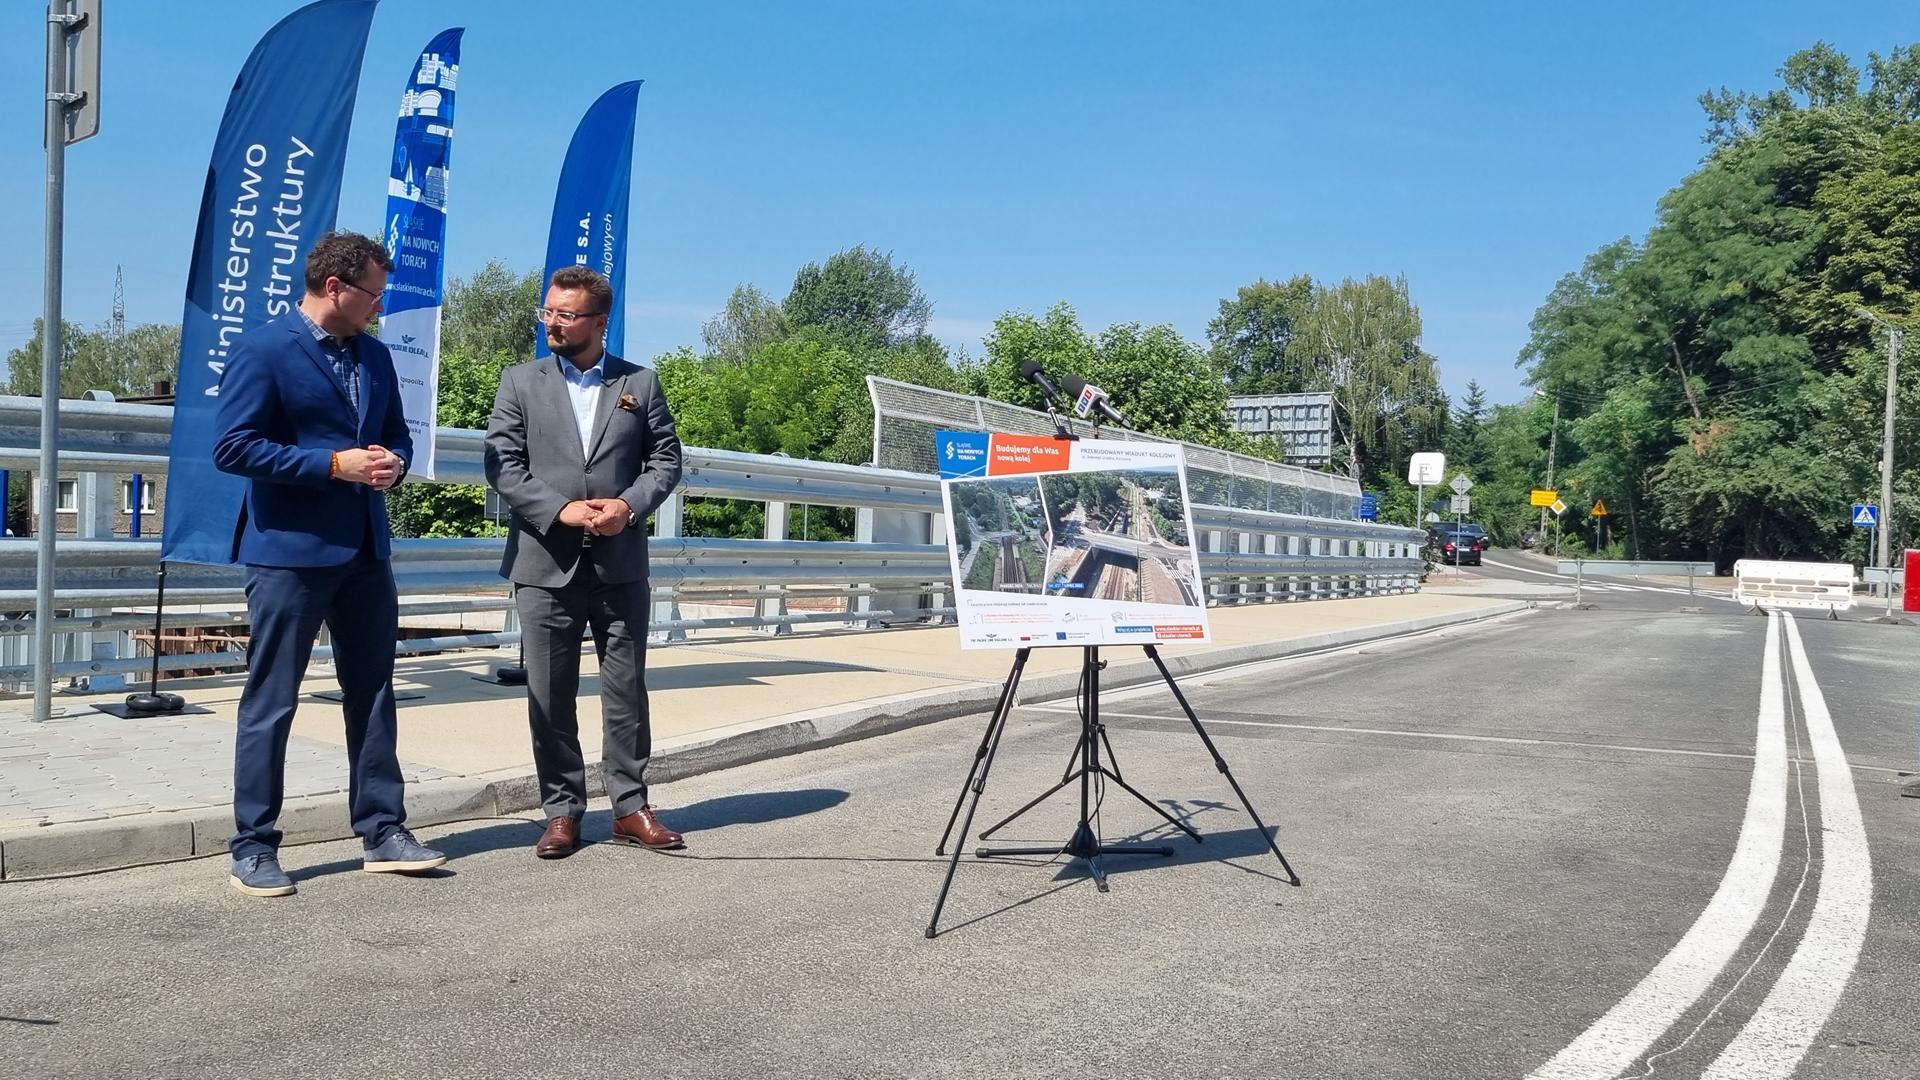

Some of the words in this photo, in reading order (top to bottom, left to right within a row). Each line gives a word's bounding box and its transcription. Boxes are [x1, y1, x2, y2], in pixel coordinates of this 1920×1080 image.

[263, 136, 314, 324] struktury
[577, 212, 591, 248] S.A.
[402, 235, 411, 248] NA
[412, 237, 440, 253] NOWYCH
[601, 213, 615, 282] lejowych
[401, 254, 427, 269] TORACH
[996, 444, 1031, 455] Budujemy
[1032, 446, 1044, 454] dla
[1044, 447, 1059, 455] Was
[1080, 448, 1124, 456] PRZEBUDOWANY
[1014, 455, 1031, 463] kolej
